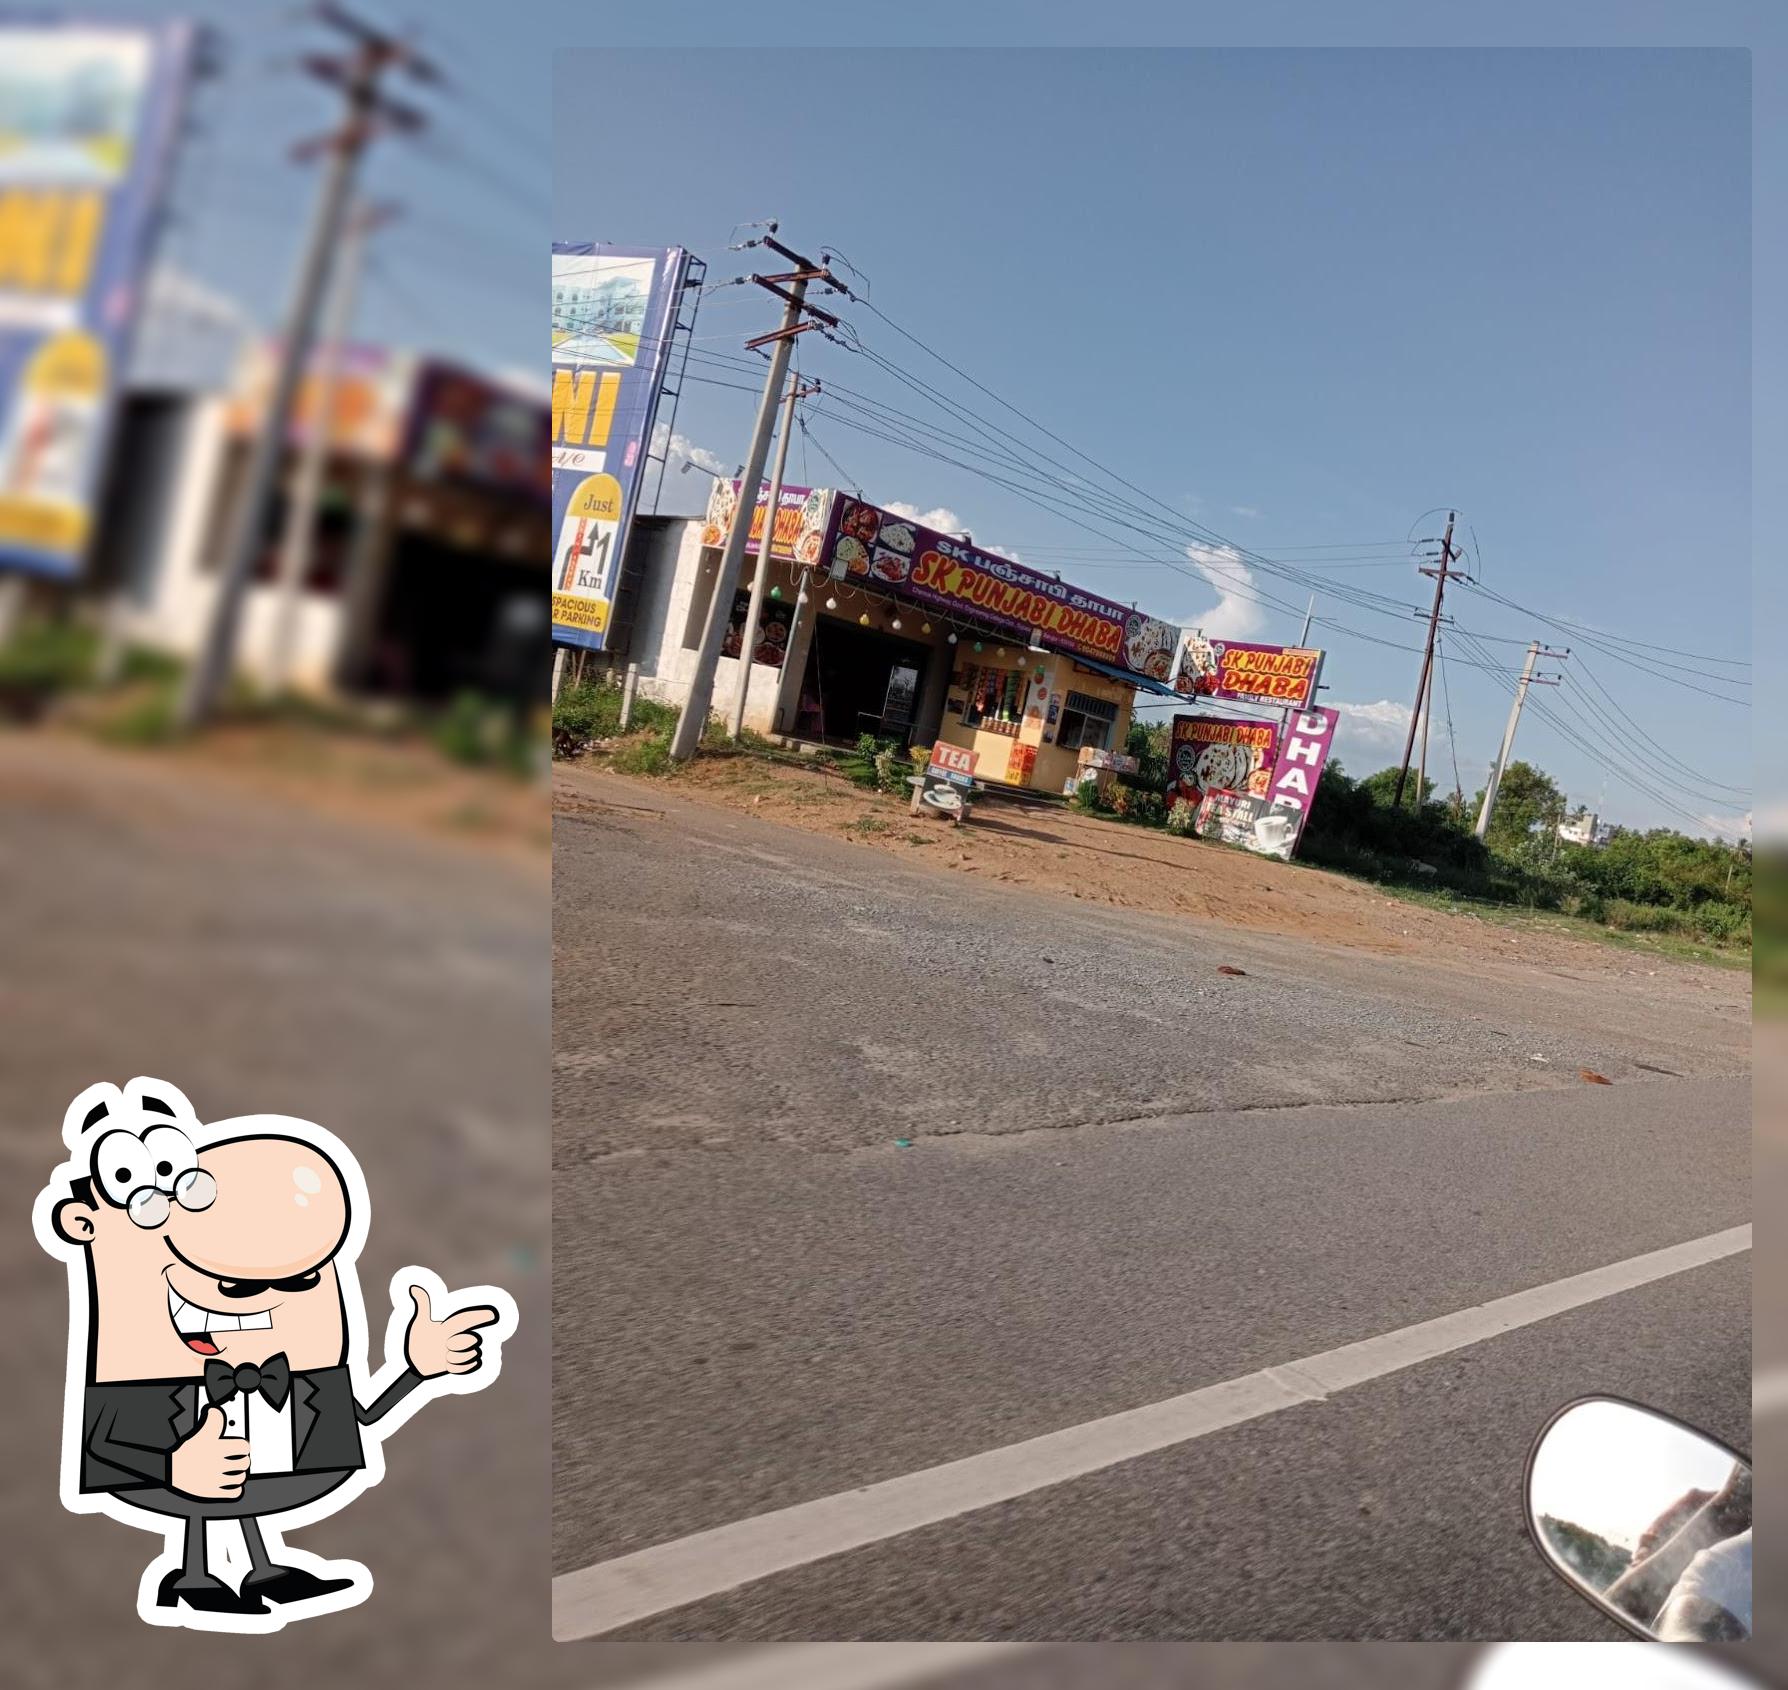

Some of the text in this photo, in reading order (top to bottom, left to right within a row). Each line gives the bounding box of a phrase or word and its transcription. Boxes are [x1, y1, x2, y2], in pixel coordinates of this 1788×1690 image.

[584, 494, 614, 513] Just
[597, 532, 611, 574] 1
[577, 569, 602, 590] Km
[936, 541, 970, 562] SK
[1070, 594, 1125, 620] தாபா
[912, 551, 959, 594] SK
[954, 568, 1058, 630] PUNJABI
[1056, 606, 1123, 652] DHABA
[561, 610, 601, 628] PARKING
[1222, 649, 1312, 677] SK PUNJABI
[1222, 670, 1309, 699] DHABA
[1259, 695, 1304, 708] RESTAURANT
[1176, 721, 1272, 748] SK PUNJABI DHABA
[939, 747, 971, 771] TEA
[1216, 794, 1251, 809] MAYURI
